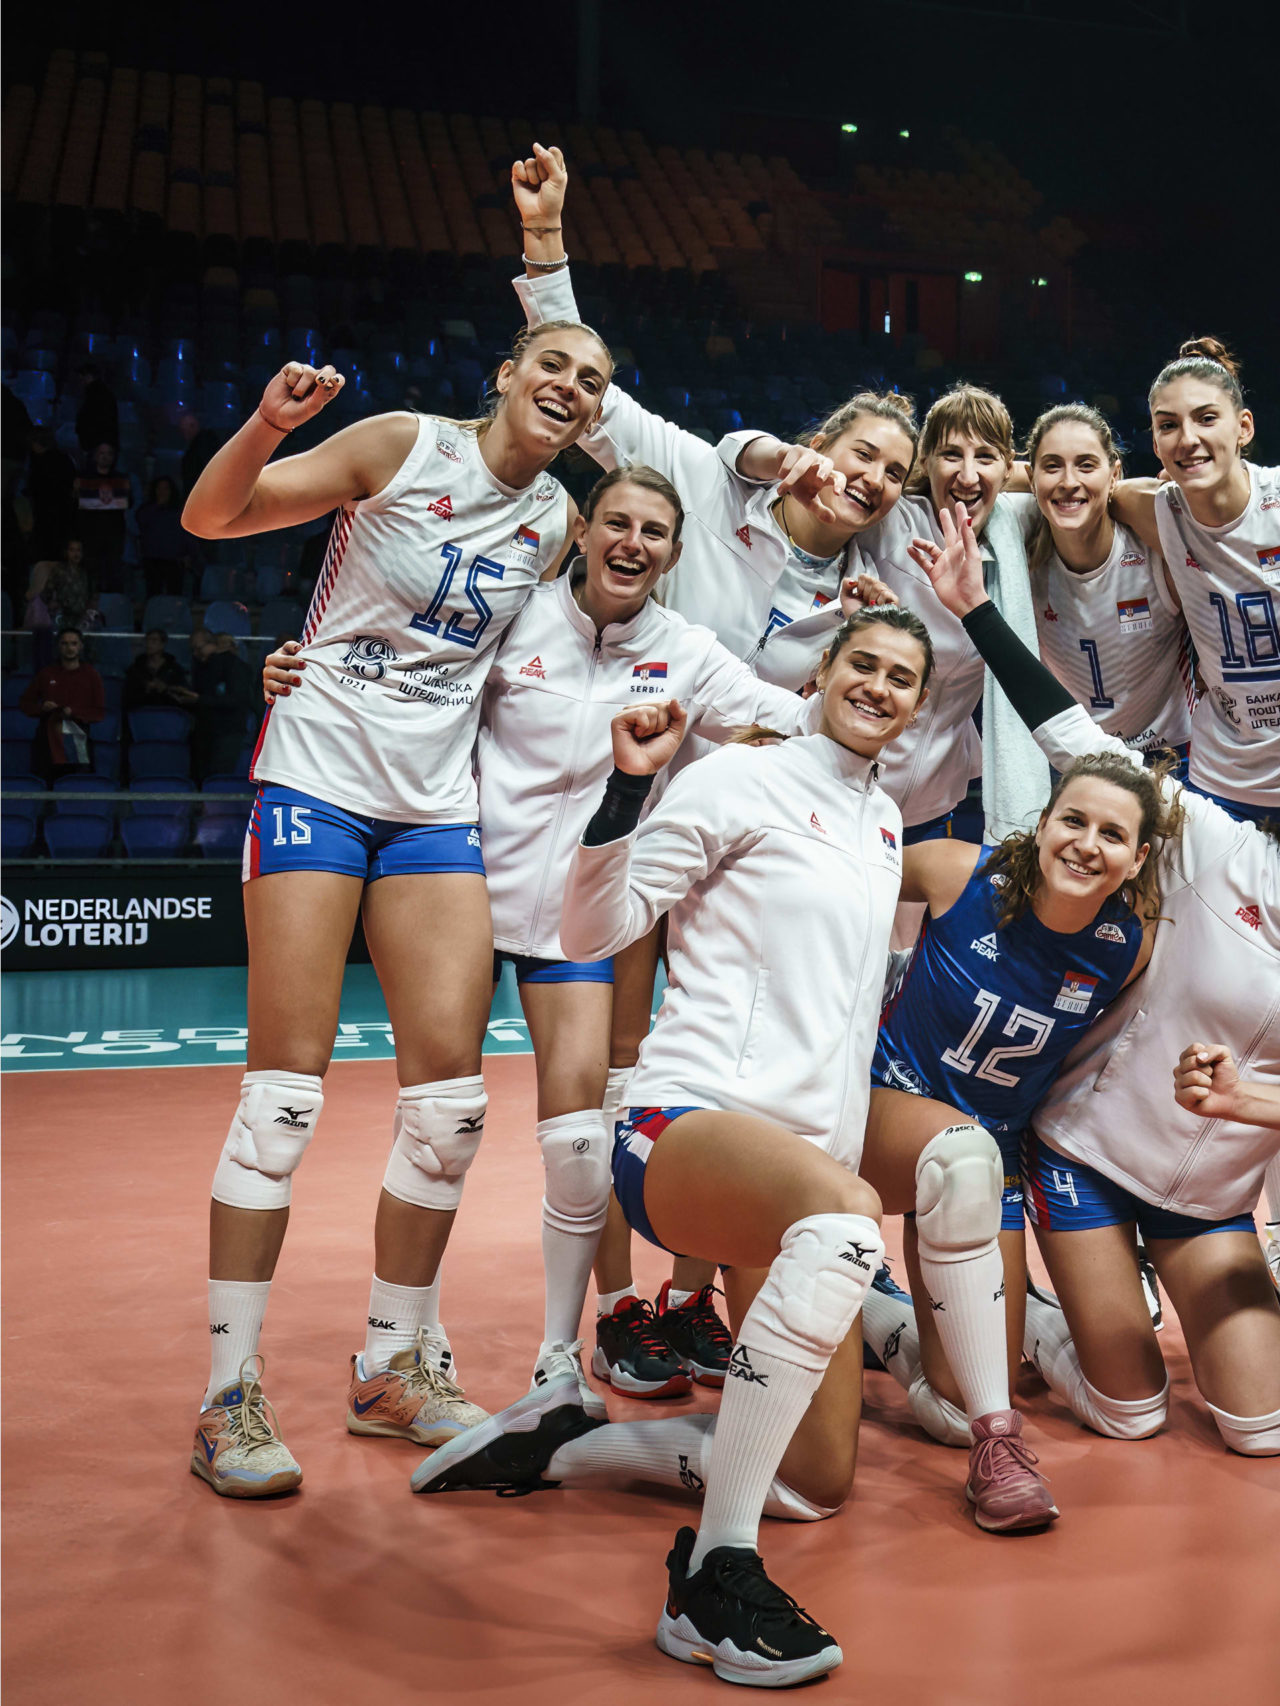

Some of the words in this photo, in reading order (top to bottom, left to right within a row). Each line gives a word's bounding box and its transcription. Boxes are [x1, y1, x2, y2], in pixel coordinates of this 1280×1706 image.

[409, 542, 504, 650] 15
[339, 675, 367, 691] 1921
[519, 666, 547, 680] PEAK
[1079, 639, 1115, 709] 1
[630, 685, 665, 694] SERBIA
[273, 806, 312, 846] 15
[24, 897, 212, 921] NEDERLANDSE
[24, 922, 149, 947] LOTERIJ
[970, 939, 1000, 962] PEAK
[940, 988, 1056, 1088] 12
[1053, 1170, 1079, 1207] 4
[729, 1364, 769, 1388] EAK
